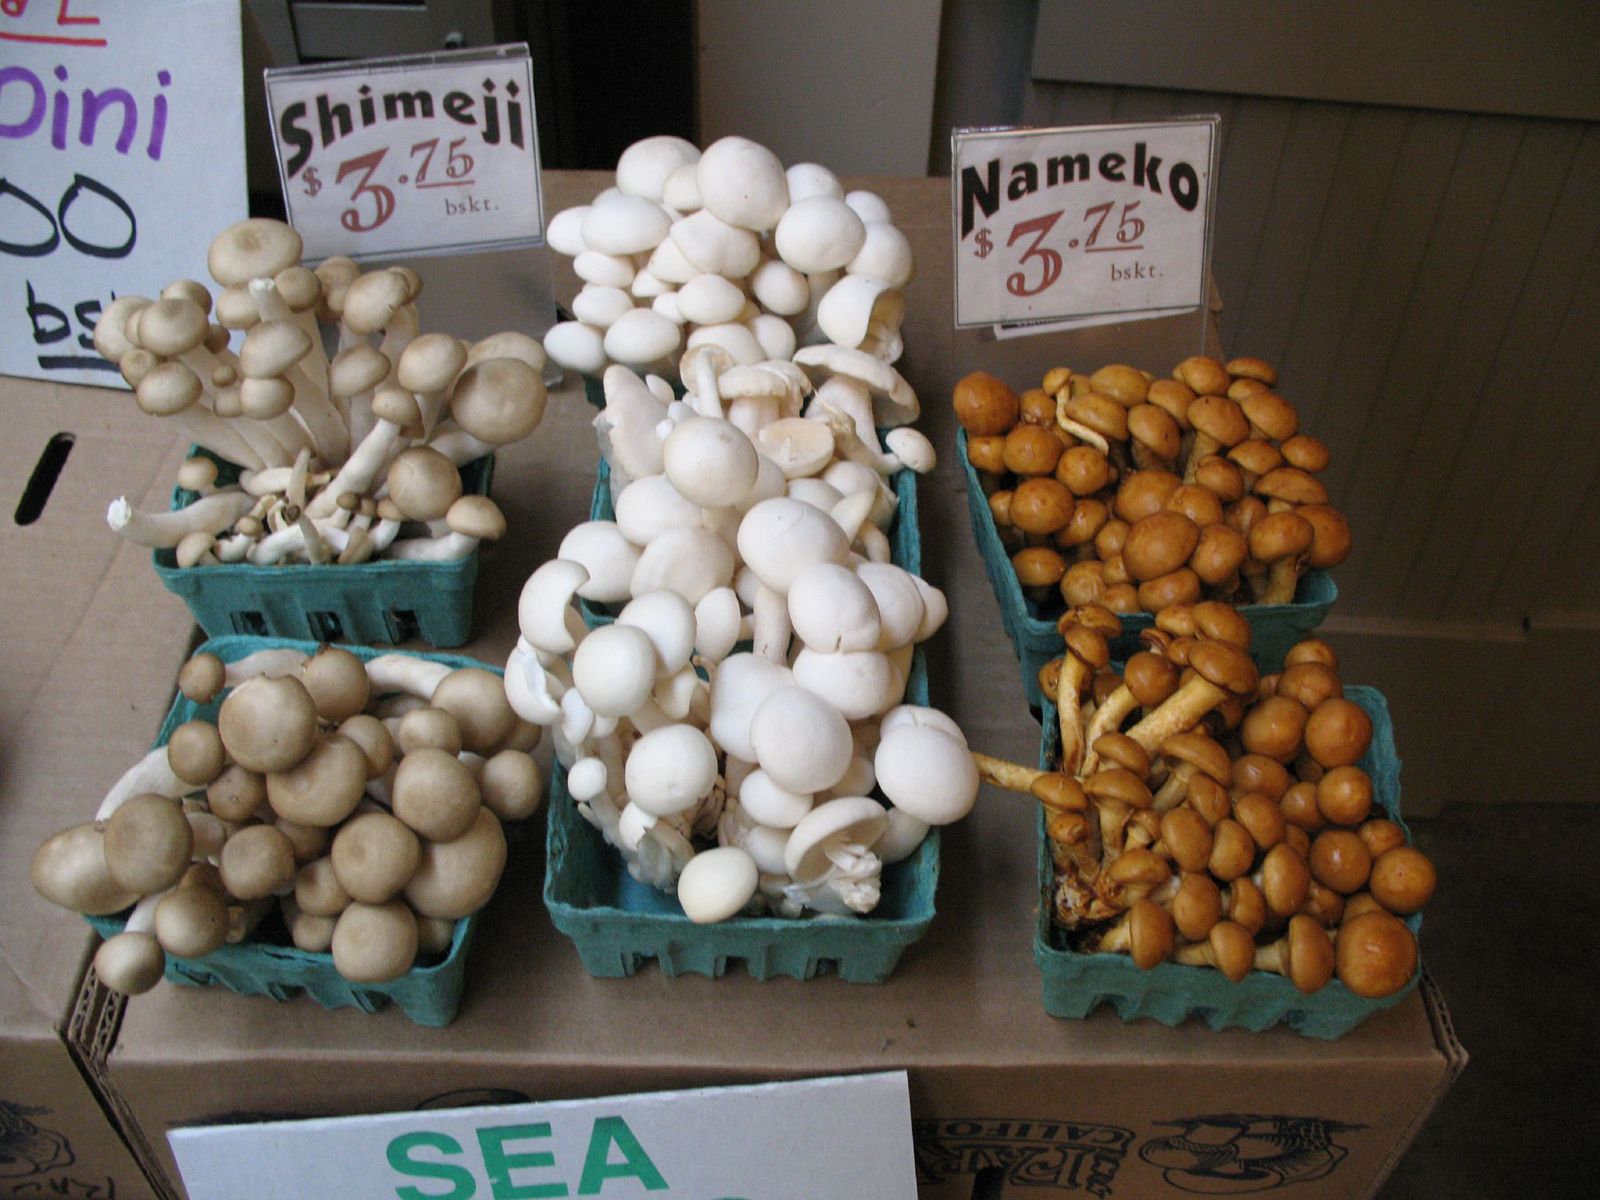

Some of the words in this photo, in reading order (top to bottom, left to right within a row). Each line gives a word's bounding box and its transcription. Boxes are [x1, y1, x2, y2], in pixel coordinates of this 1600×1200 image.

[280, 76, 525, 180] Shimeji
[302, 137, 475, 233] $3.75
[445, 196, 499, 216] bskt.
[961, 142, 1200, 243] Nameko
[974, 200, 1145, 297] $3.75
[1111, 261, 1163, 282] bskt.
[26, 279, 116, 350] bs
[386, 1115, 669, 1200] SEA
